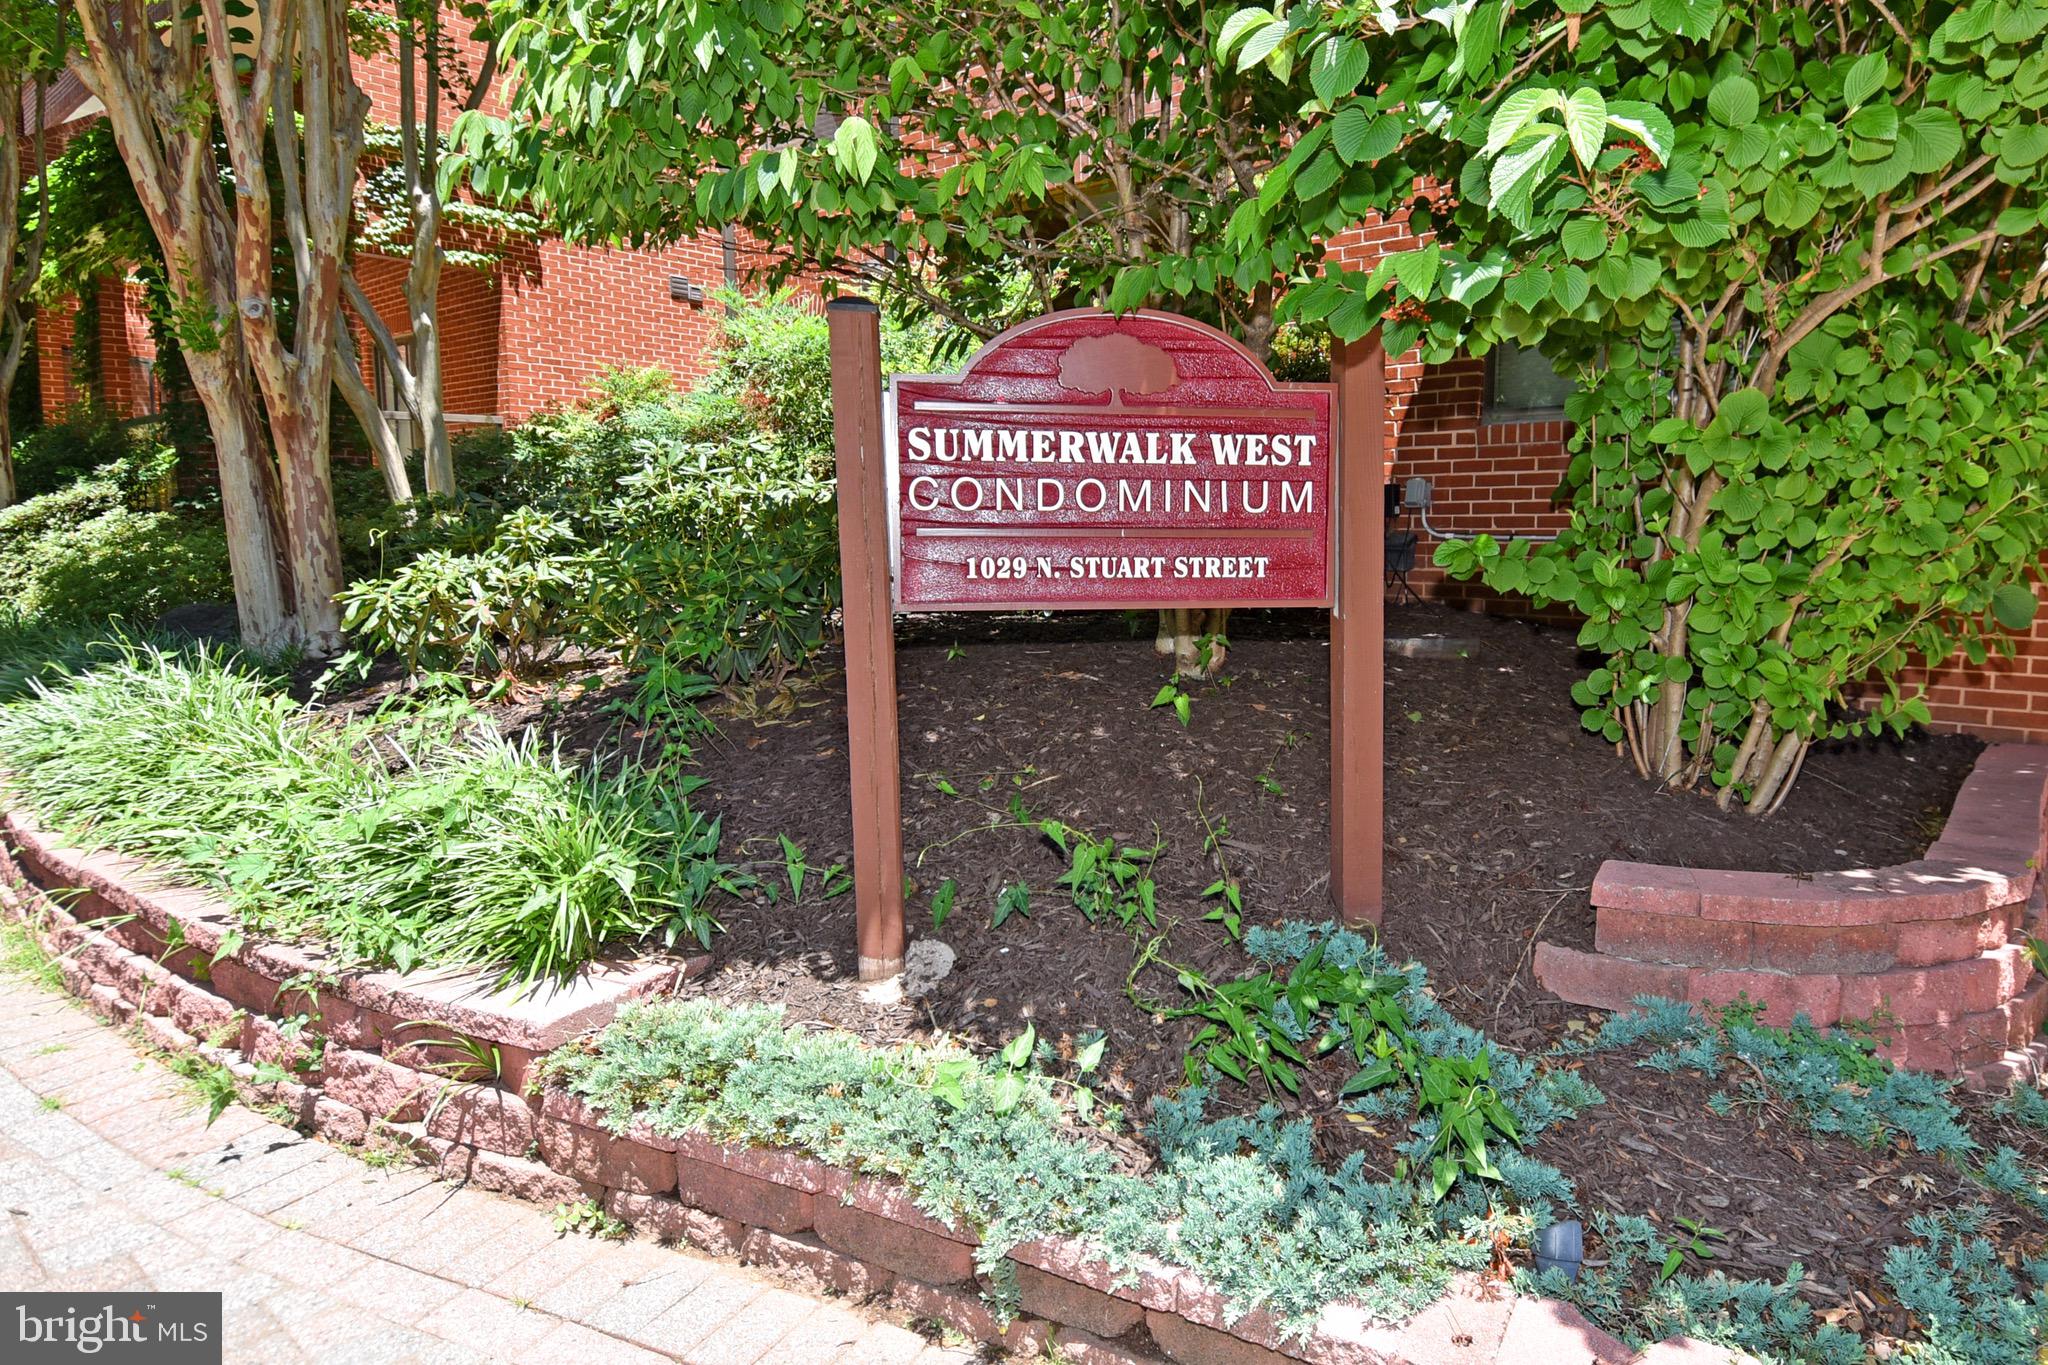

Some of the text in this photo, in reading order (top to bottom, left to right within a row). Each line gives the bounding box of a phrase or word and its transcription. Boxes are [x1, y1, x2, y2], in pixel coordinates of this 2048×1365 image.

[907, 426, 1317, 467] SUMMERWALK WEST
[907, 476, 1314, 514] CONDOMINIUM
[965, 556, 1269, 580] 1029 N. STUART STREET
